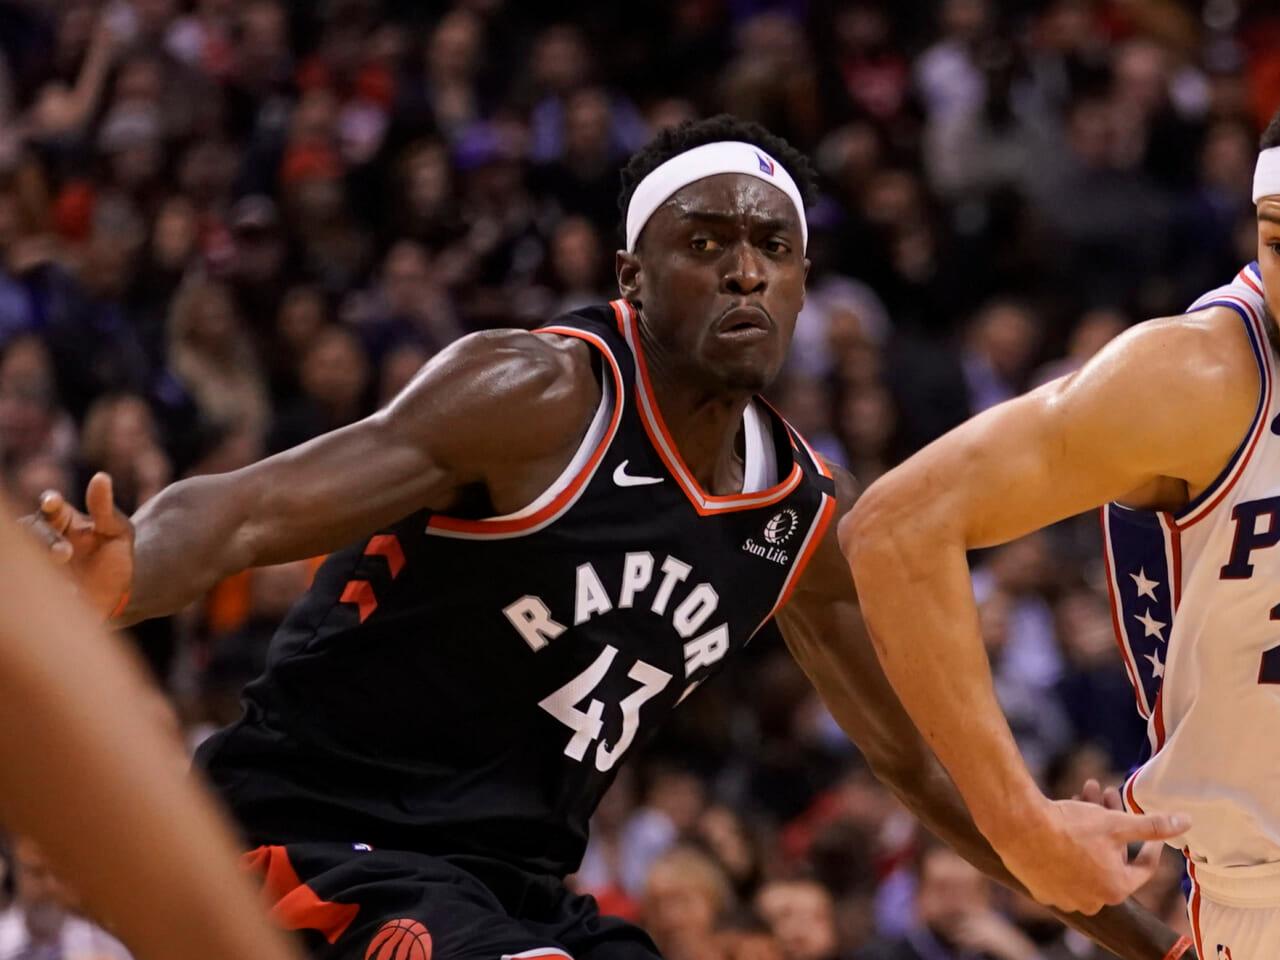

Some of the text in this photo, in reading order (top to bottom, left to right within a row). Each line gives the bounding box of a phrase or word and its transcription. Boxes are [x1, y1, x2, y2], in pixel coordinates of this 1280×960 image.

[742, 538, 788, 565] Sun Life
[502, 551, 730, 709] RAPTOR
[537, 644, 674, 772] 43
